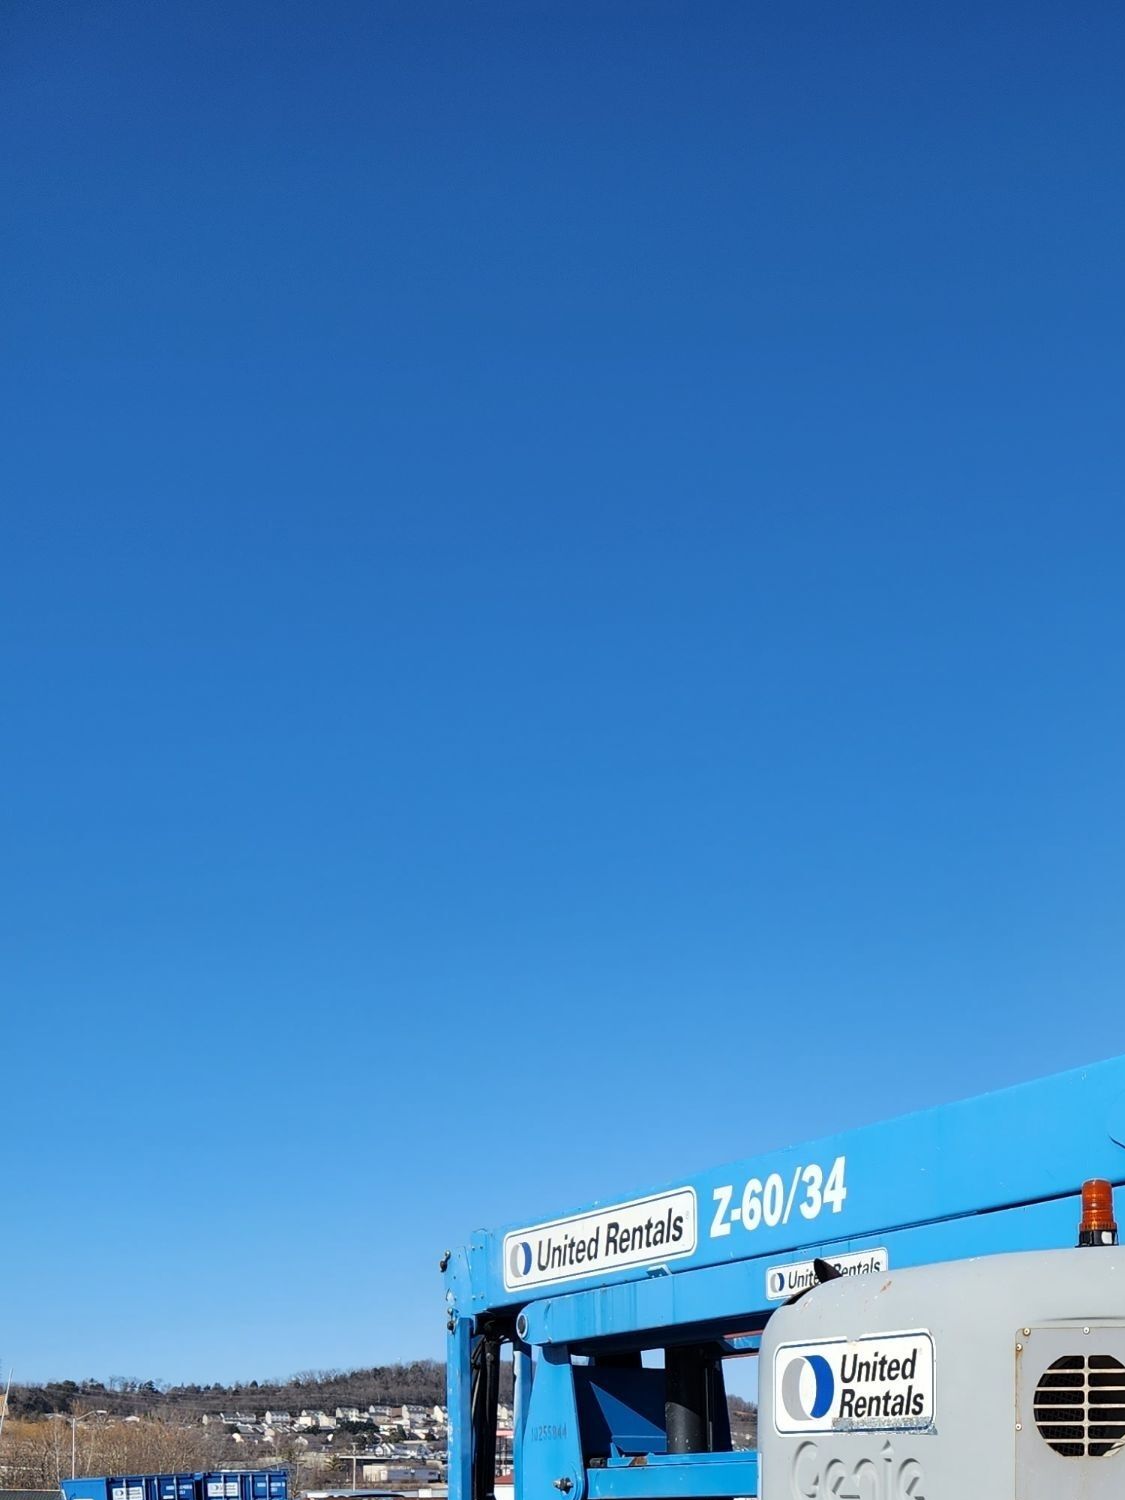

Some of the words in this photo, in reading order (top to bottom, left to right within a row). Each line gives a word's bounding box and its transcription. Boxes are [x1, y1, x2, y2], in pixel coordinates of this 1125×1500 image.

[709, 1155, 847, 1238] Z-60/34
[537, 1231, 599, 1271] United
[605, 1208, 684, 1257] Rentals
[788, 1267, 820, 1289] Unite
[840, 1348, 918, 1383] United
[839, 1385, 924, 1418] Rentals
